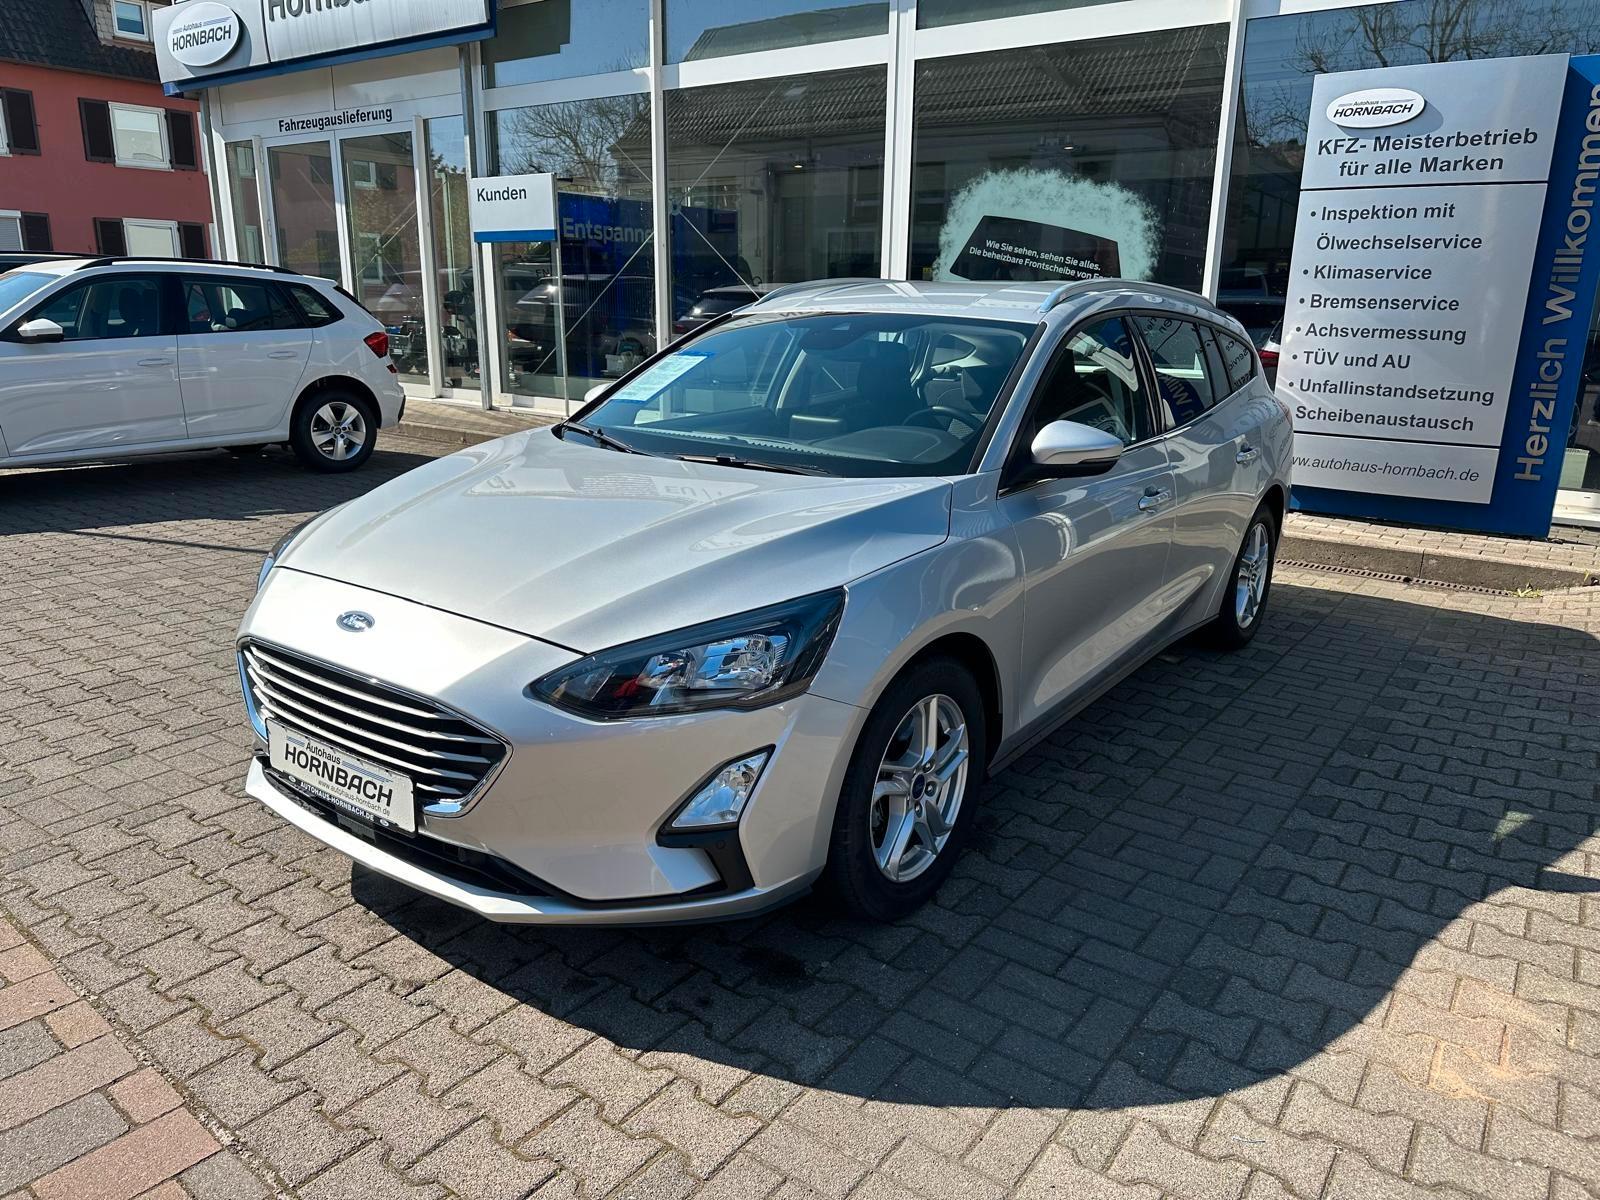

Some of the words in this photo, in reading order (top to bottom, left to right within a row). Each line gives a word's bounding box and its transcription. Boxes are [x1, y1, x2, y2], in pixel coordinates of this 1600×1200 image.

[172, 24, 232, 52] HORNBACH
[278, 106, 393, 133] Fahrzeugauslieferung
[1333, 103, 1414, 118] HORNBACH
[1318, 137, 1367, 155] KFZ-
[1373, 127, 1538, 152] Meisterbetrieb
[1339, 161, 1369, 176] für
[1374, 158, 1412, 175] alle
[1419, 155, 1504, 173] Marken
[476, 186, 527, 202] Kunden
[1321, 204, 1417, 223] Inspektion
[1424, 203, 1455, 218] mit
[1316, 232, 1482, 251] Ölwechselservice
[969, 246, 982, 256] Die
[982, 249, 1024, 265] beheizbare
[1024, 259, 1076, 276] Frontscheibe
[1076, 270, 1092, 279] von
[985, 240, 1000, 250] Wie
[1001, 242, 1013, 252] Sie
[1013, 245, 1039, 259] sehen,
[1040, 251, 1064, 263] sehen
[1065, 256, 1078, 266] Sie
[1079, 259, 1101, 271] alles.
[1313, 265, 1432, 280] Klimaservice
[1309, 293, 1459, 311] Bremsenservice
[1304, 323, 1467, 345] Achsvermessung
[1303, 348, 1339, 366] TÜV
[1343, 352, 1377, 368] und
[1382, 354, 1411, 369] AU
[1299, 378, 1495, 406] Unfallinstandsetzung
[1295, 405, 1475, 431] Scheibenaustausch
[1514, 338, 1568, 481] Herzlich
[305, 743, 341, 765] Autohaus
[284, 742, 393, 807] HORNBACH
[300, 781, 375, 821] AUTOHAUS-HORNBACH.DE
